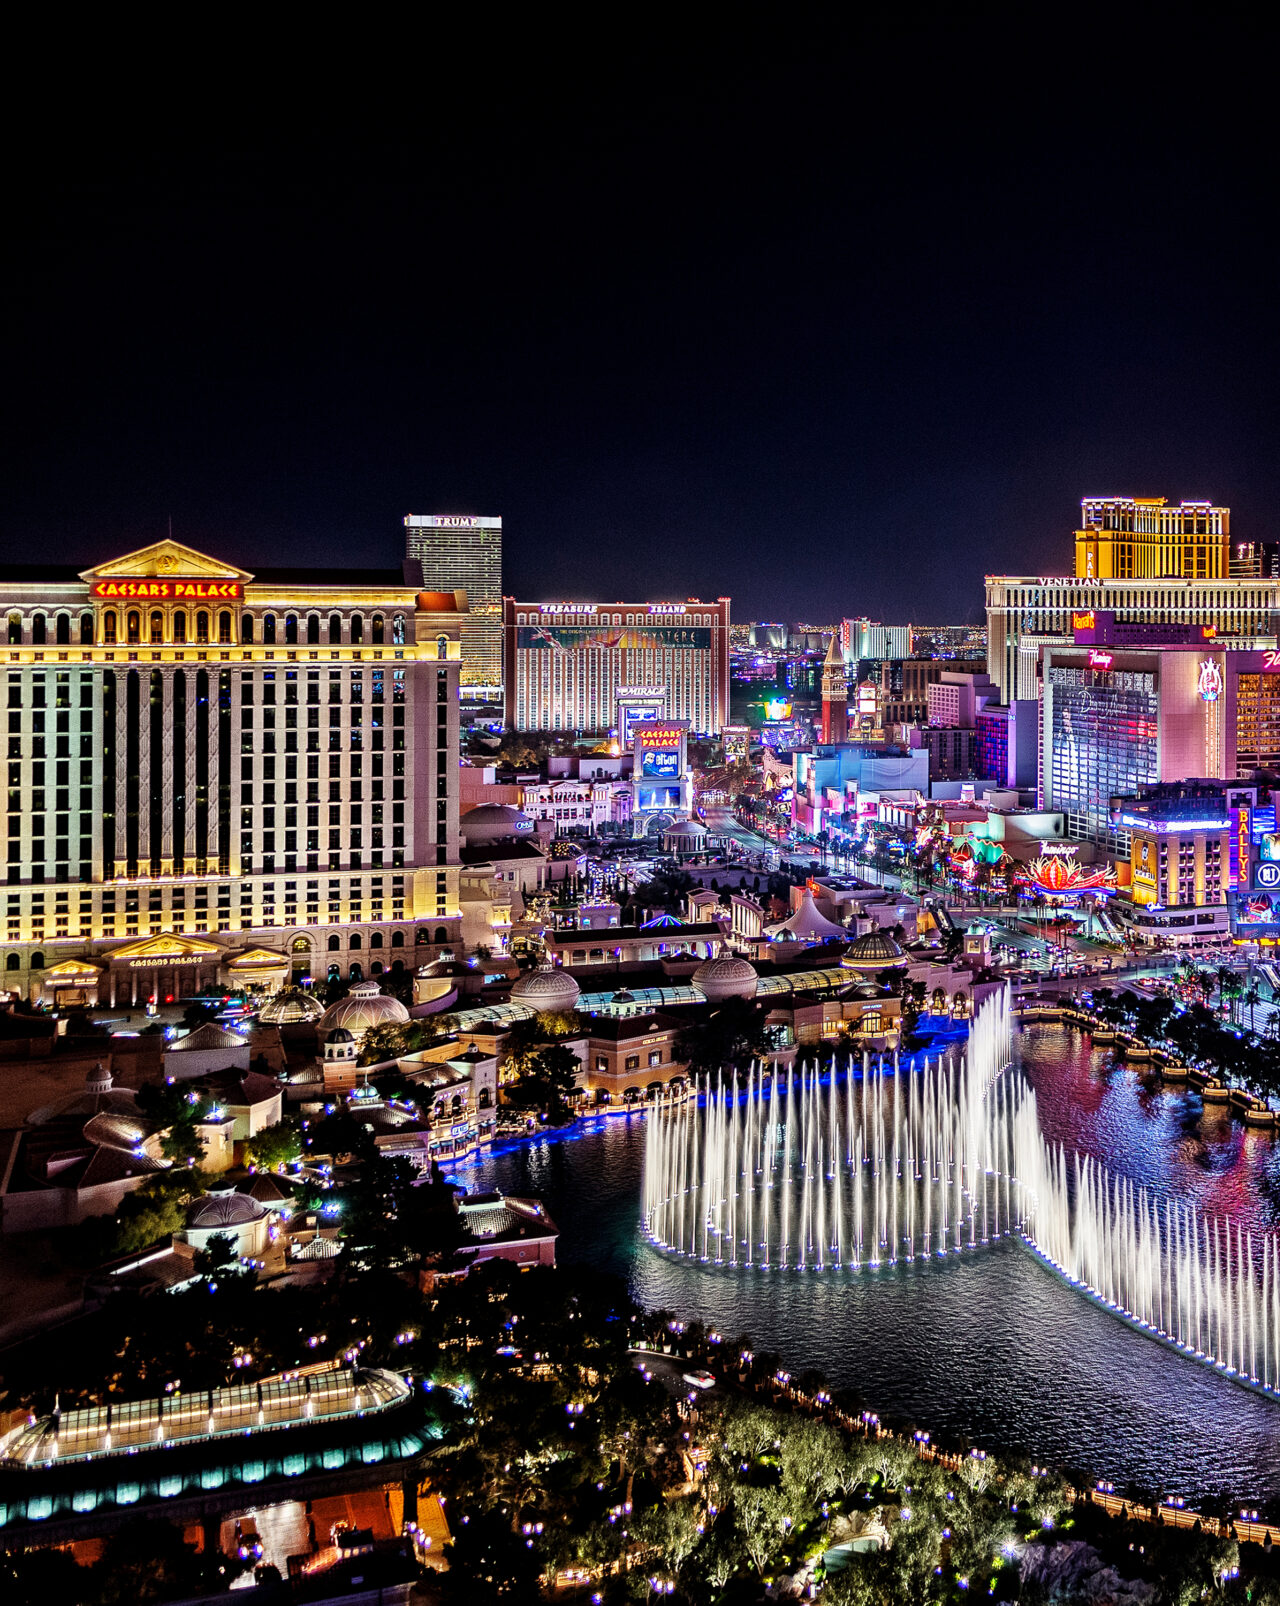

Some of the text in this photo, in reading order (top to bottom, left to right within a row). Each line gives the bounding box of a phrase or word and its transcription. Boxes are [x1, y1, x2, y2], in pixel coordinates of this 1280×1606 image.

[435, 517, 477, 526] TRUMP
[1039, 578, 1100, 586] VENETIAN
[96, 583, 238, 596] CAESARS PALACE
[540, 605, 687, 614] TREASURE ISLAND
[640, 730, 681, 738] CAESARS
[642, 739, 680, 747] PALACE
[656, 753, 678, 766] elton
[1238, 811, 1249, 882] BALLYS
[129, 956, 202, 967] CAESARS PALACE
